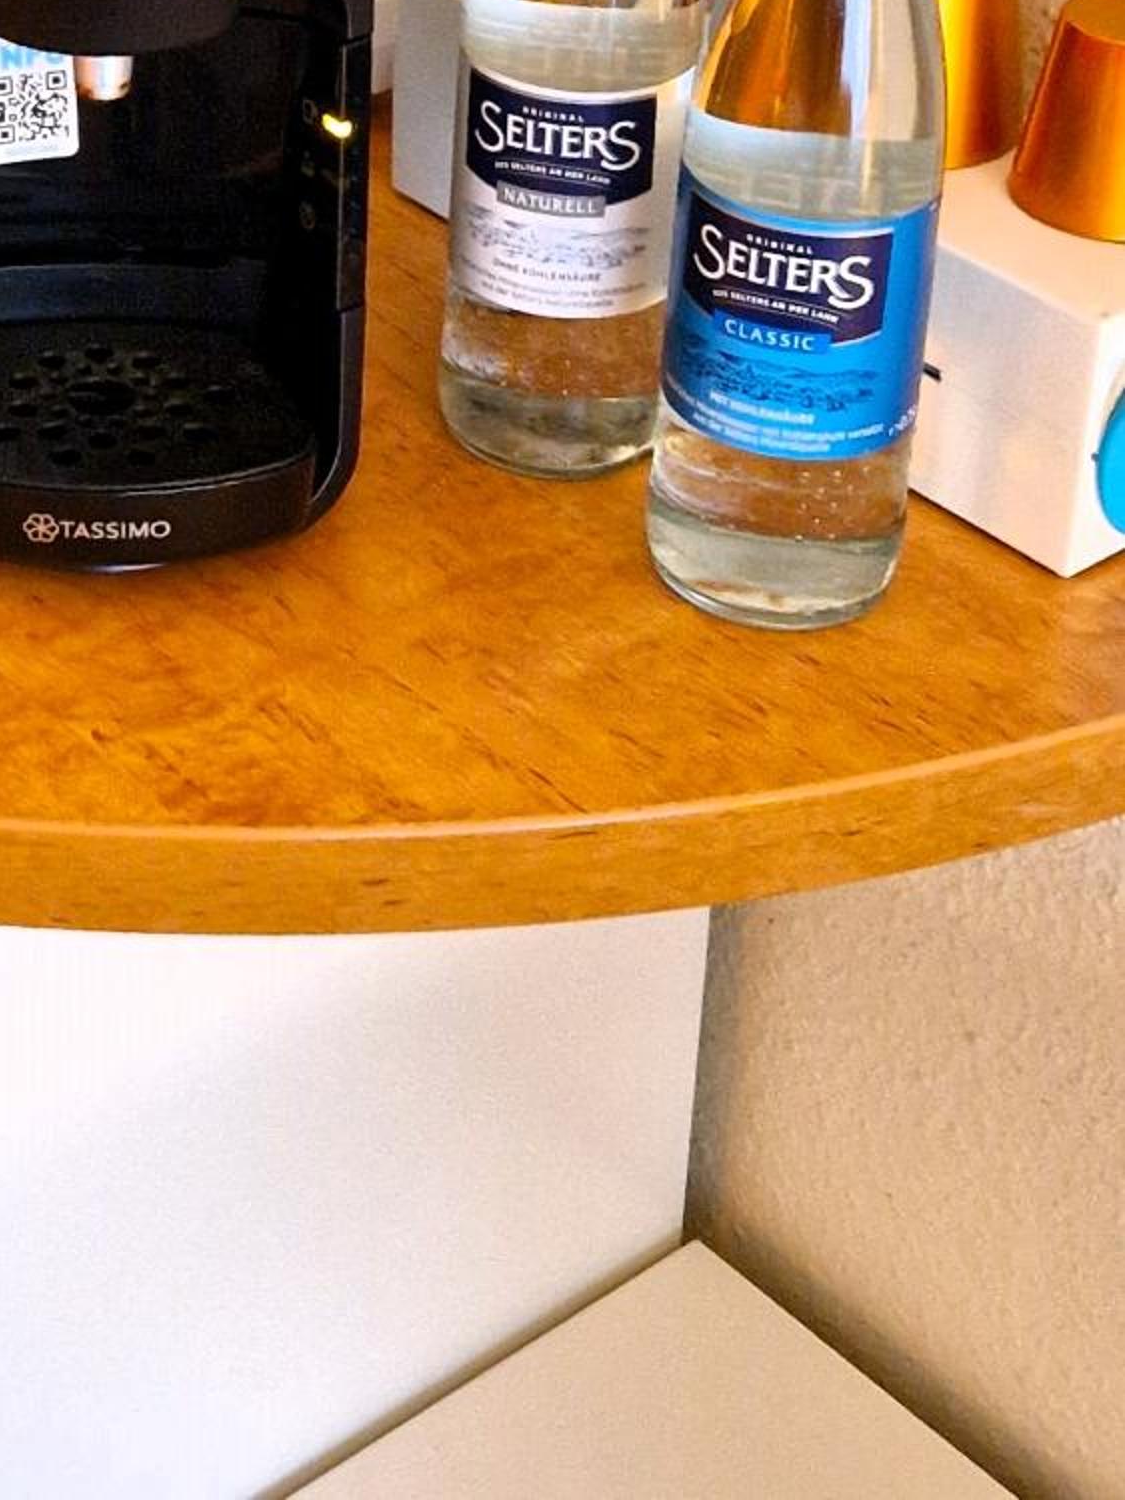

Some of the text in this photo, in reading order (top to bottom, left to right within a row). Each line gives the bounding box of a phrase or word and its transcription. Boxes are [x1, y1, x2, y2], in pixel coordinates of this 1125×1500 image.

[475, 100, 641, 171] SELTERS
[504, 187, 598, 214] NATURELL
[693, 224, 874, 310] SELTERS
[724, 319, 815, 350] CLASSIC
[59, 520, 172, 540] TASSIMO
